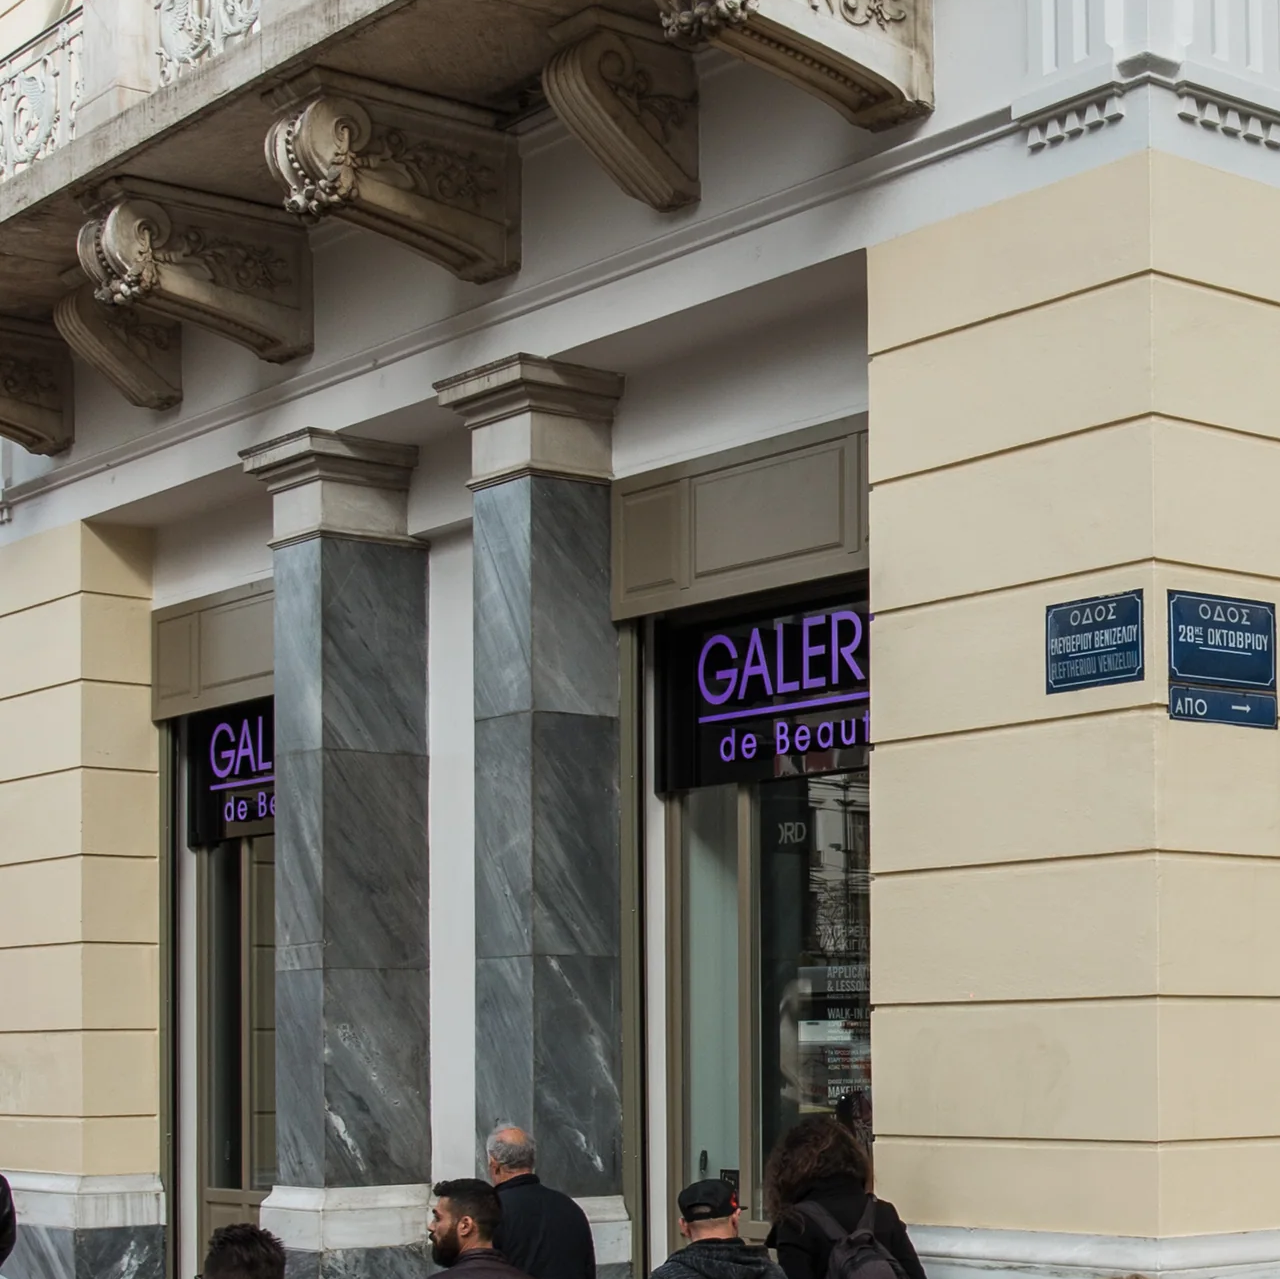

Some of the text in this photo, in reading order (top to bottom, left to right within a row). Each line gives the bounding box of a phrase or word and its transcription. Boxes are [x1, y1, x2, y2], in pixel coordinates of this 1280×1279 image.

[1069, 603, 1117, 626] ΟΔΟΣ
[1199, 603, 1250, 625] ΟΔΟΣ
[1094, 624, 1138, 648] ΒΕΝΙΖΕΛΟΥ
[1207, 628, 1269, 652] ΟΚΤΩΒΡΙΟΥ
[1175, 698, 1208, 716] ΑΠΟ
[719, 728, 757, 762] de
[224, 795, 248, 822] de
